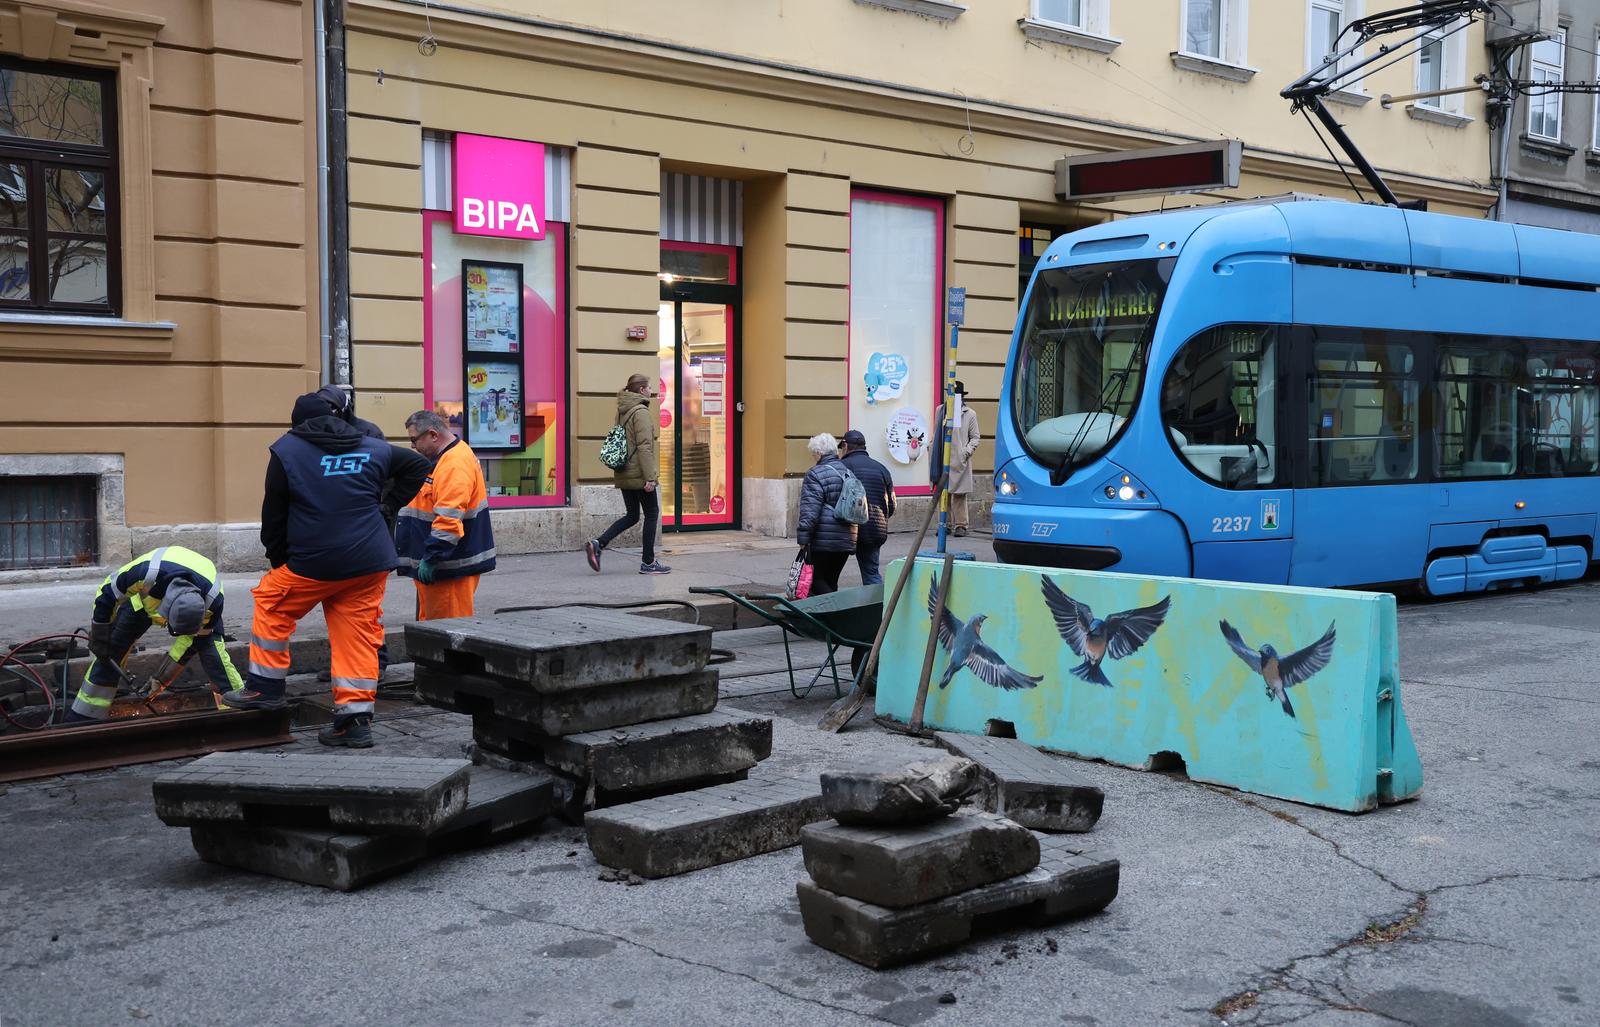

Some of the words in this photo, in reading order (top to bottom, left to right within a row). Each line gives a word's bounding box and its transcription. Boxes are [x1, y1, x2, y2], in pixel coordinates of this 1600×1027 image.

[463, 197, 540, 233] BIPA
[320, 453, 370, 476] ZET
[1031, 522, 1058, 537] ZET
[1212, 516, 1252, 533] 2237
